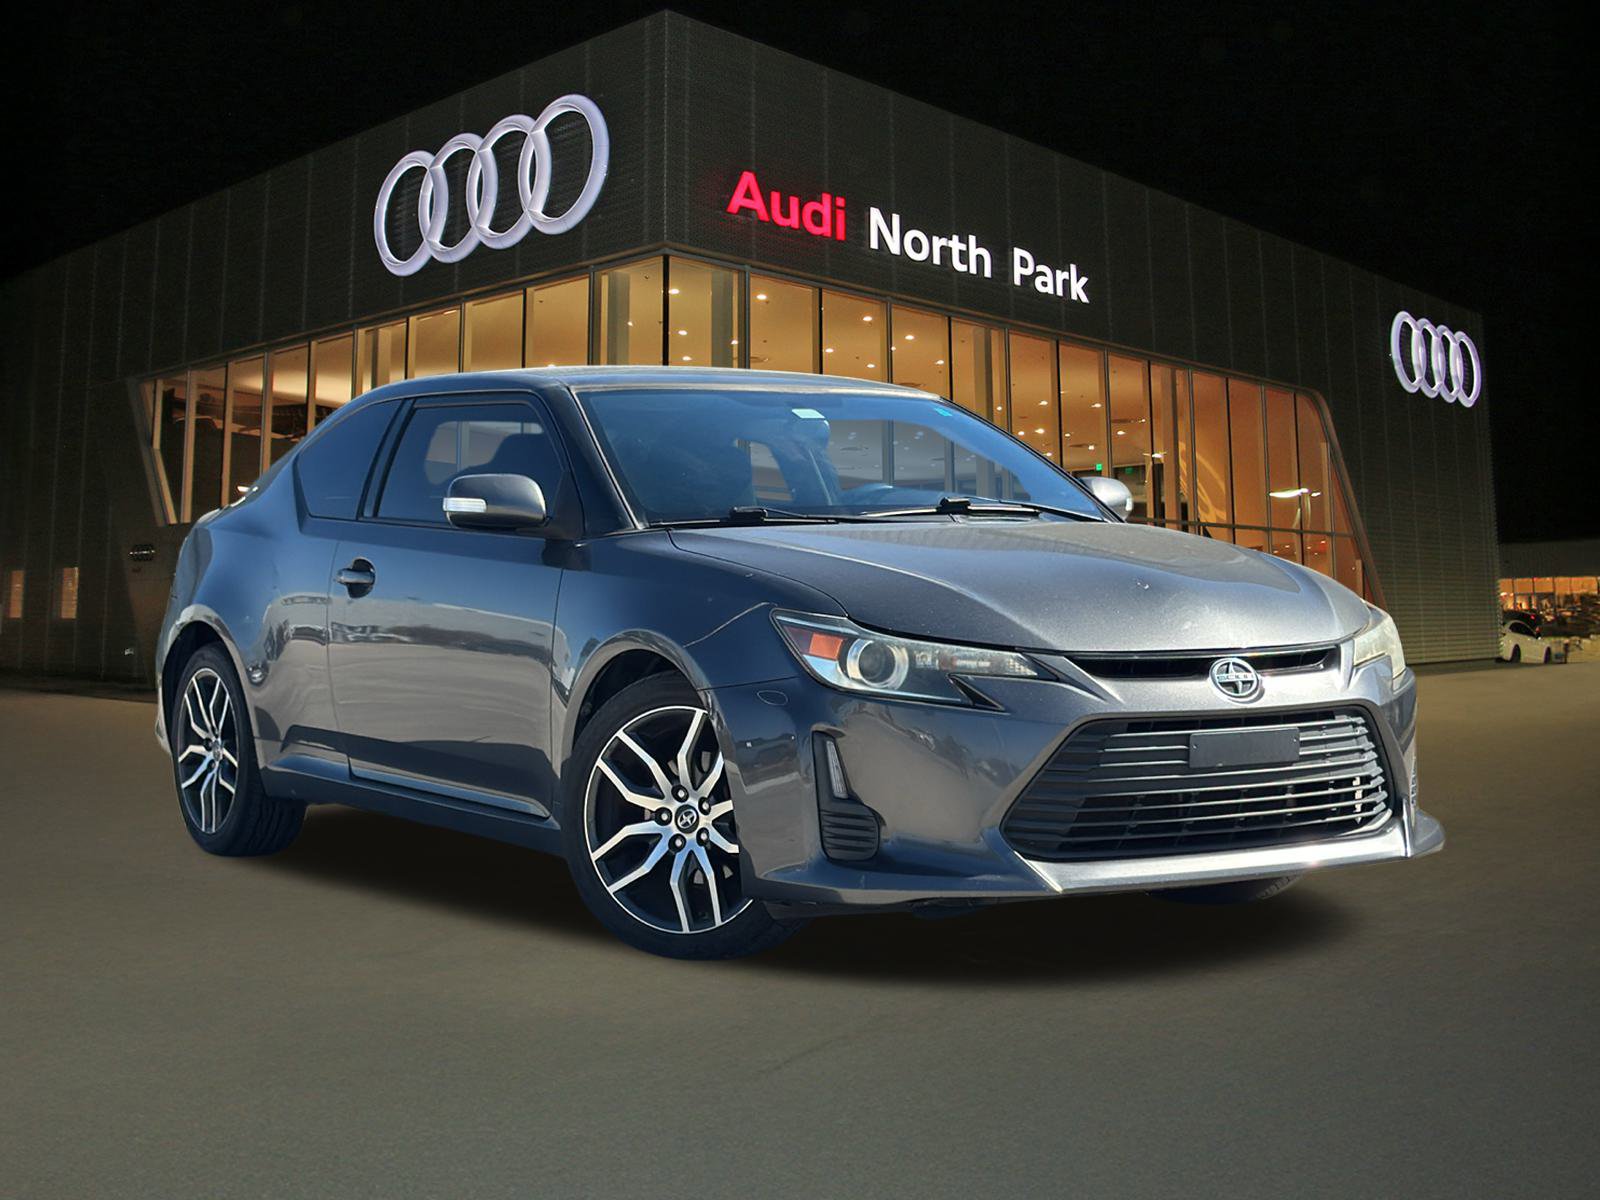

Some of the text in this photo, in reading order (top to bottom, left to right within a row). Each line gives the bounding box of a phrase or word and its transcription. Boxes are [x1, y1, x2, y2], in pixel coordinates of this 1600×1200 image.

[726, 171, 1090, 304] Audi North Park
